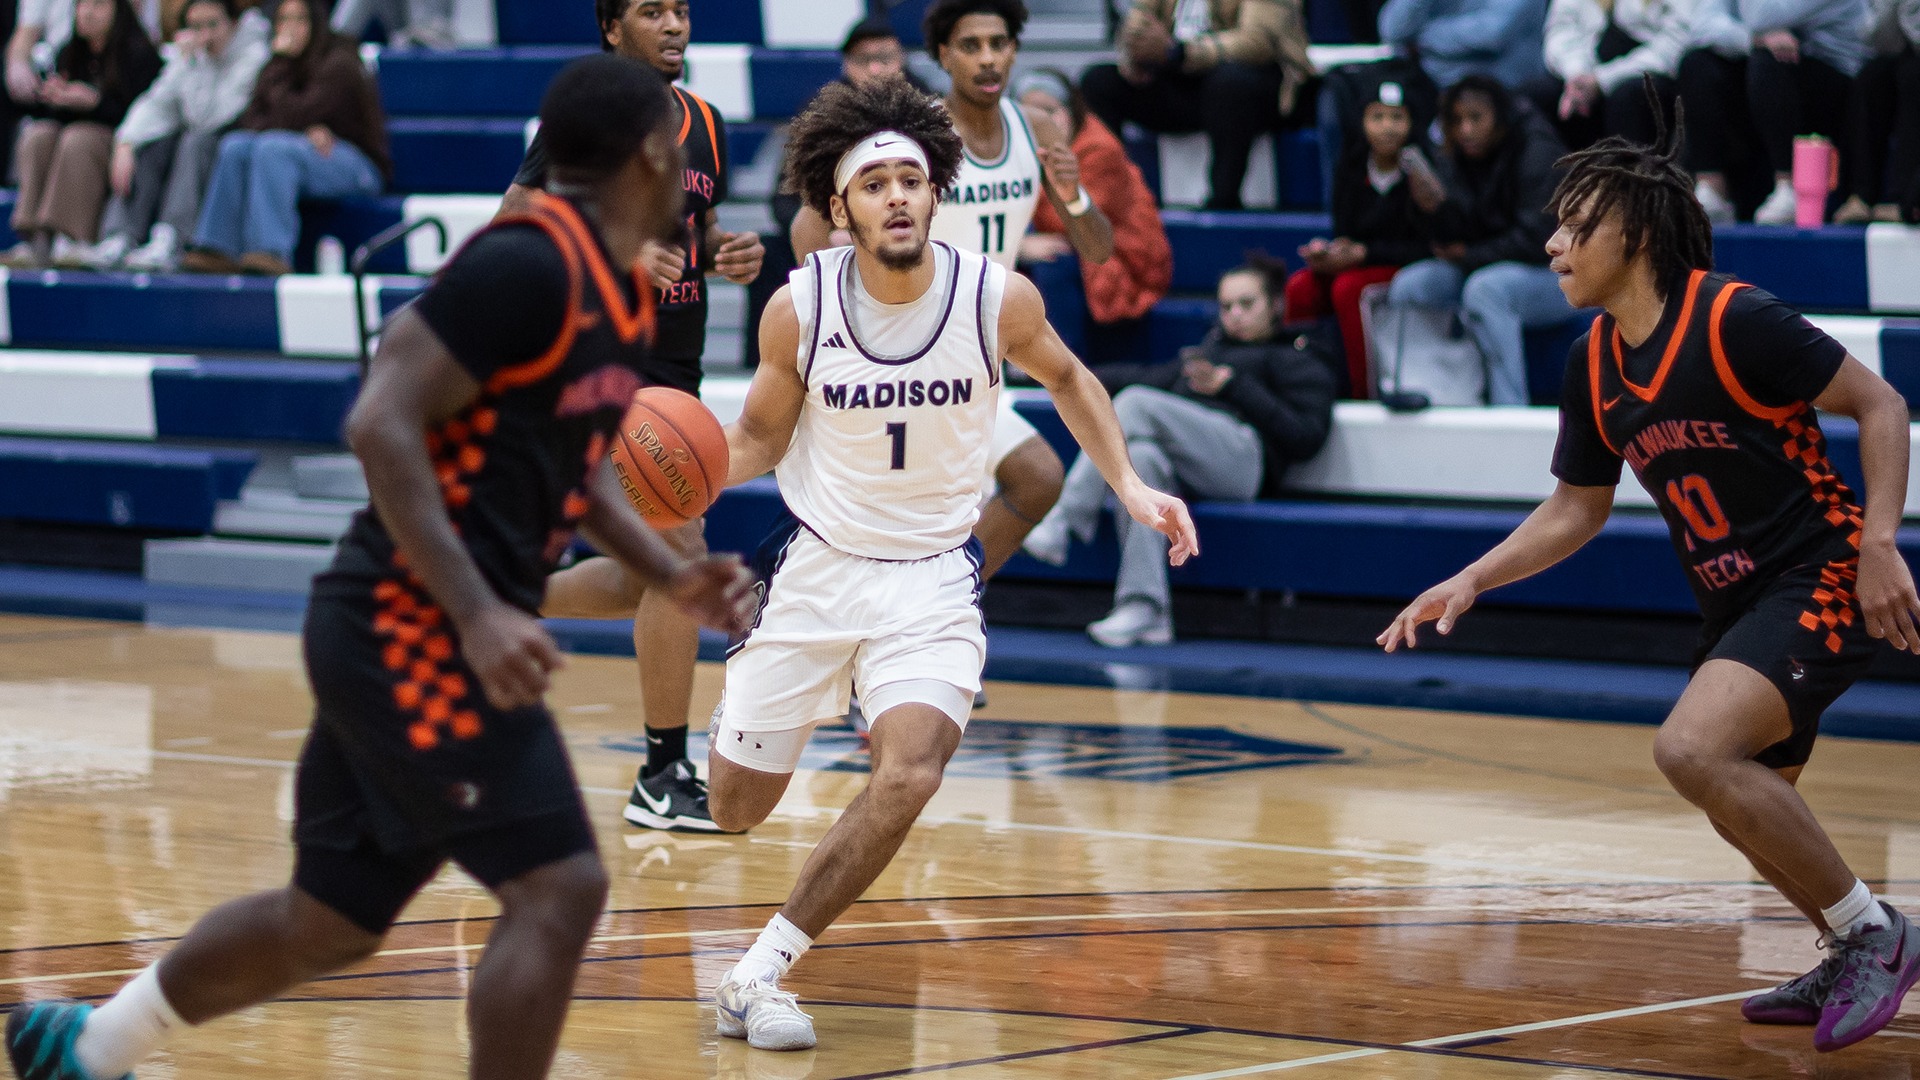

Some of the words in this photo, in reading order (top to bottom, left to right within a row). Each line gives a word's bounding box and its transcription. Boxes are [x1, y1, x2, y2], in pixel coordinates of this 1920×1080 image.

[942, 178, 1032, 205] MADISON
[978, 212, 1005, 254] 11
[822, 377, 973, 410] MADISON
[629, 421, 699, 510] SPALDING
[884, 421, 907, 470] 1
[1623, 420, 1739, 474] ILWAUKEE
[609, 449, 661, 516] LEGACY
[1666, 473, 1730, 552] 10
[1692, 548, 1755, 591] TECH
